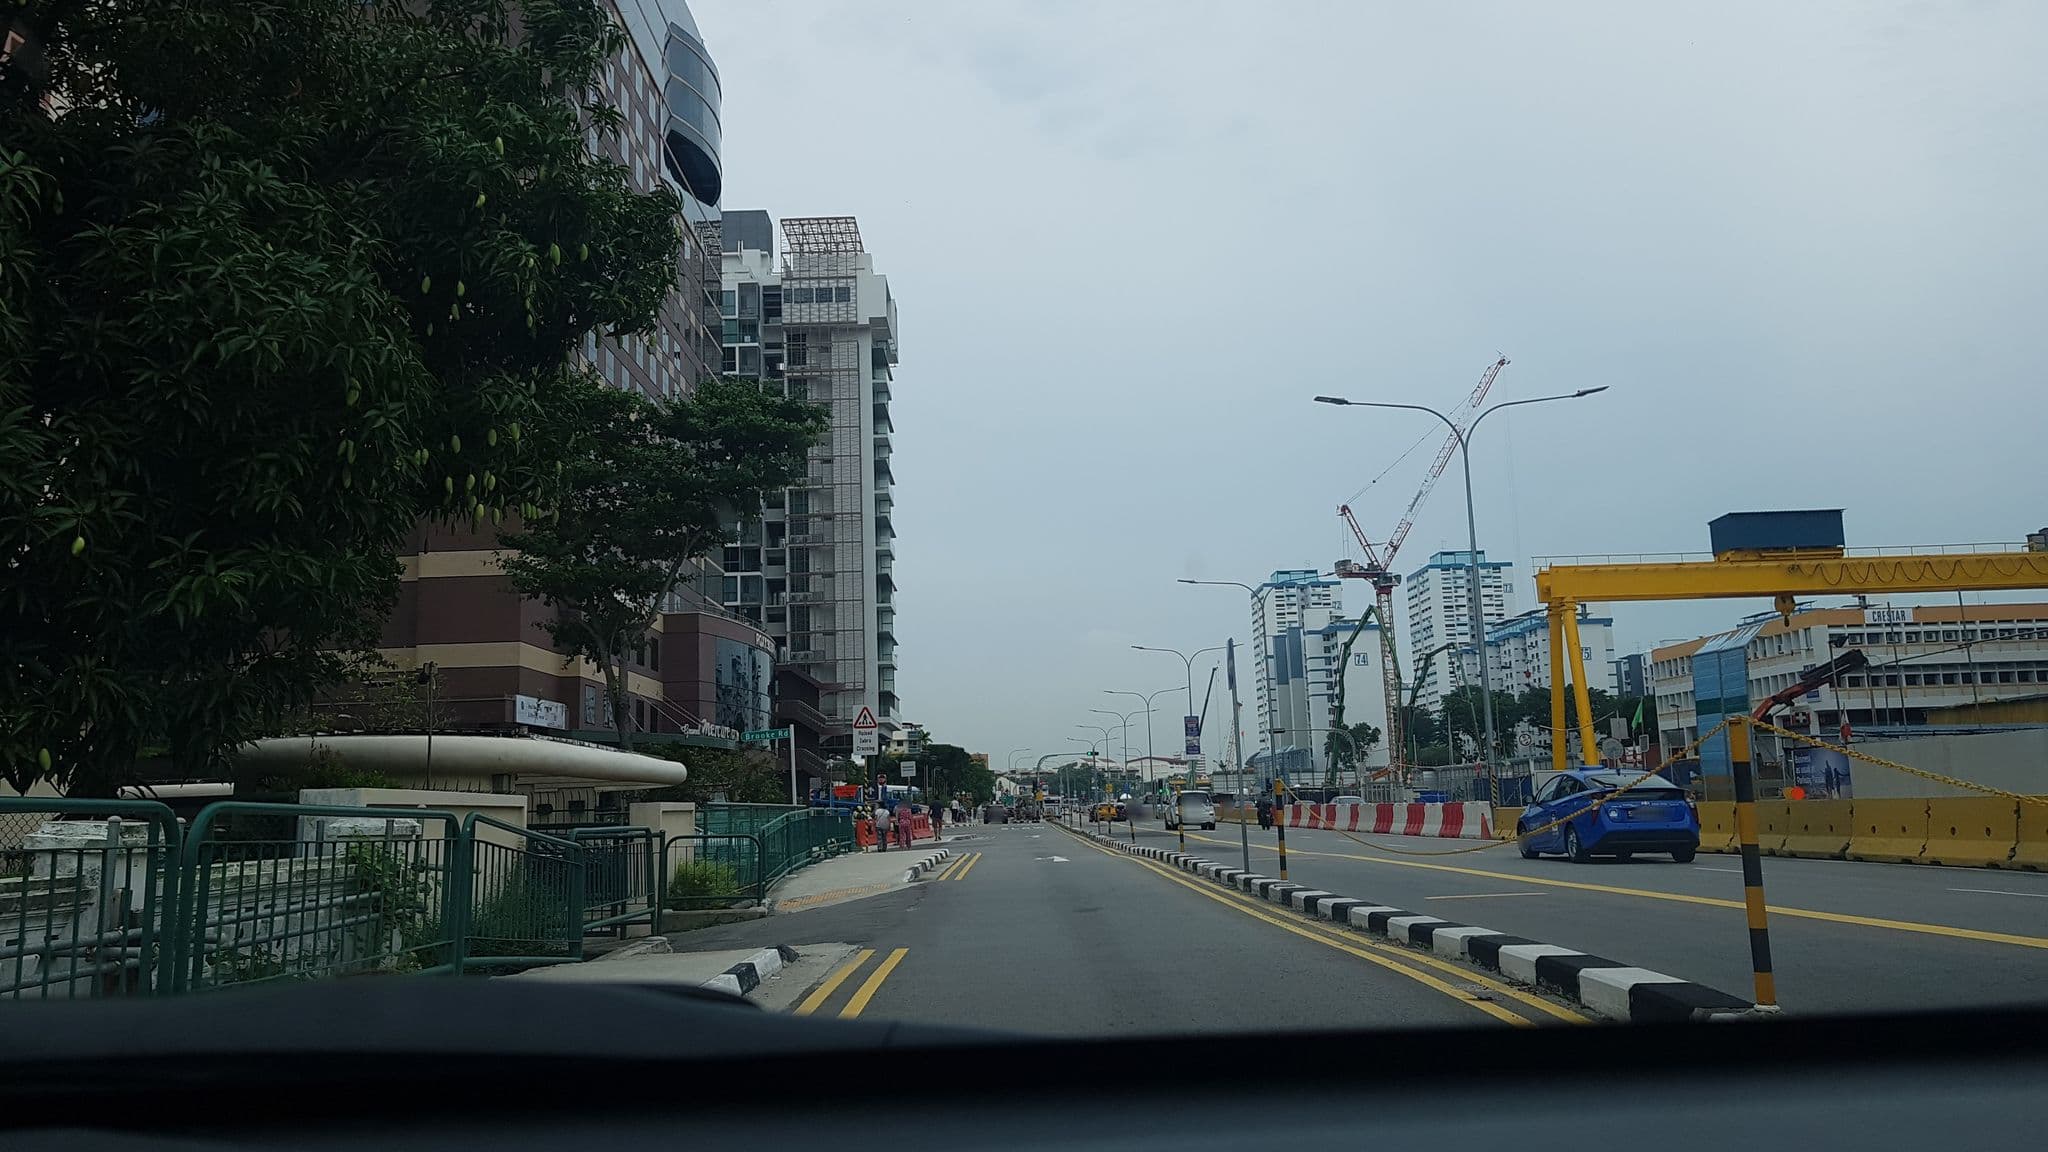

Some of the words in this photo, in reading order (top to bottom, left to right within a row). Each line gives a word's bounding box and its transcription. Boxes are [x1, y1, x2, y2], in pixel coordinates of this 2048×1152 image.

[1872, 610, 1906, 622] CRESTAR
[1355, 654, 1366, 665] 74
[745, 732, 775, 741] Brooke
[778, 729, 789, 738] Rd
